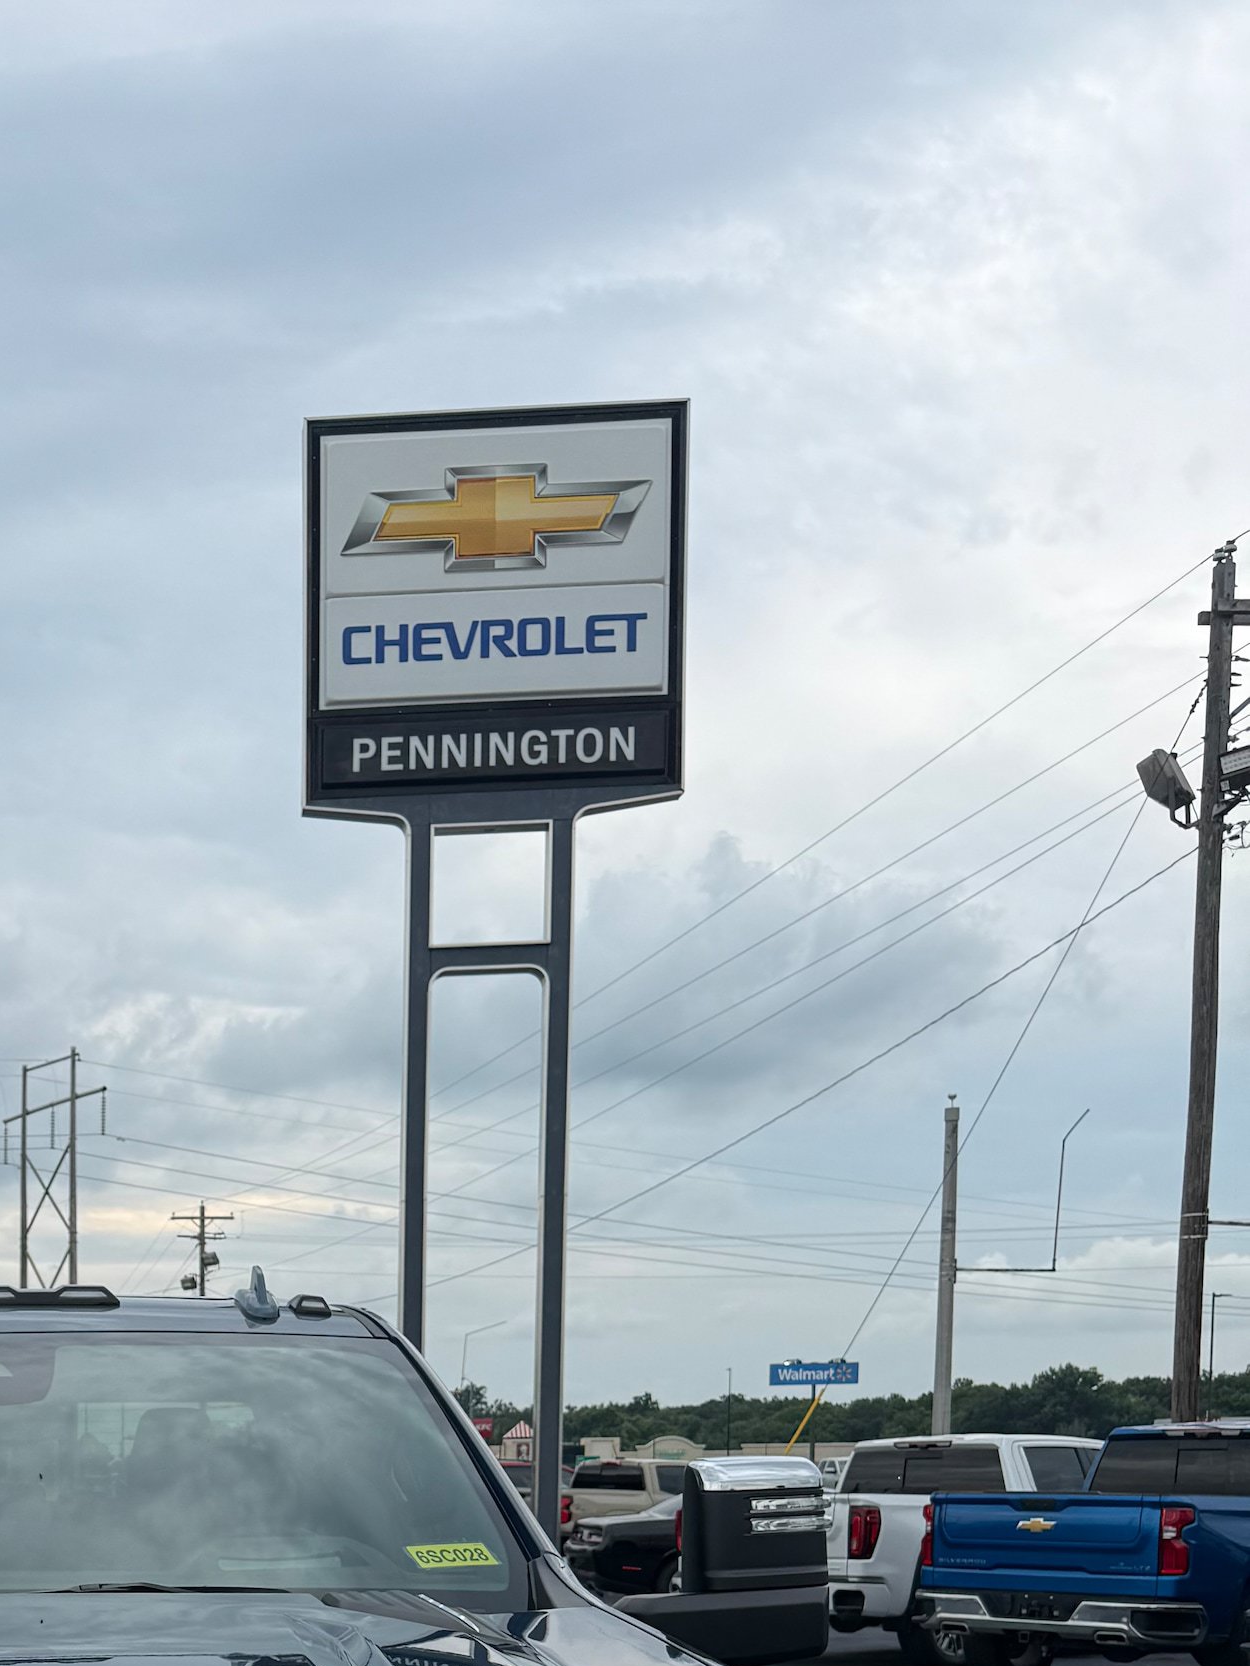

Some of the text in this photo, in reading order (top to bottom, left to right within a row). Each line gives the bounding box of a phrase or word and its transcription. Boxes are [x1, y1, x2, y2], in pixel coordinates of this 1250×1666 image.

[342, 612, 648, 665] CHEVROLET
[352, 726, 636, 773] PENNINGTON
[778, 1368, 835, 1381] Walmart
[415, 1548, 490, 1564] 6SC028
